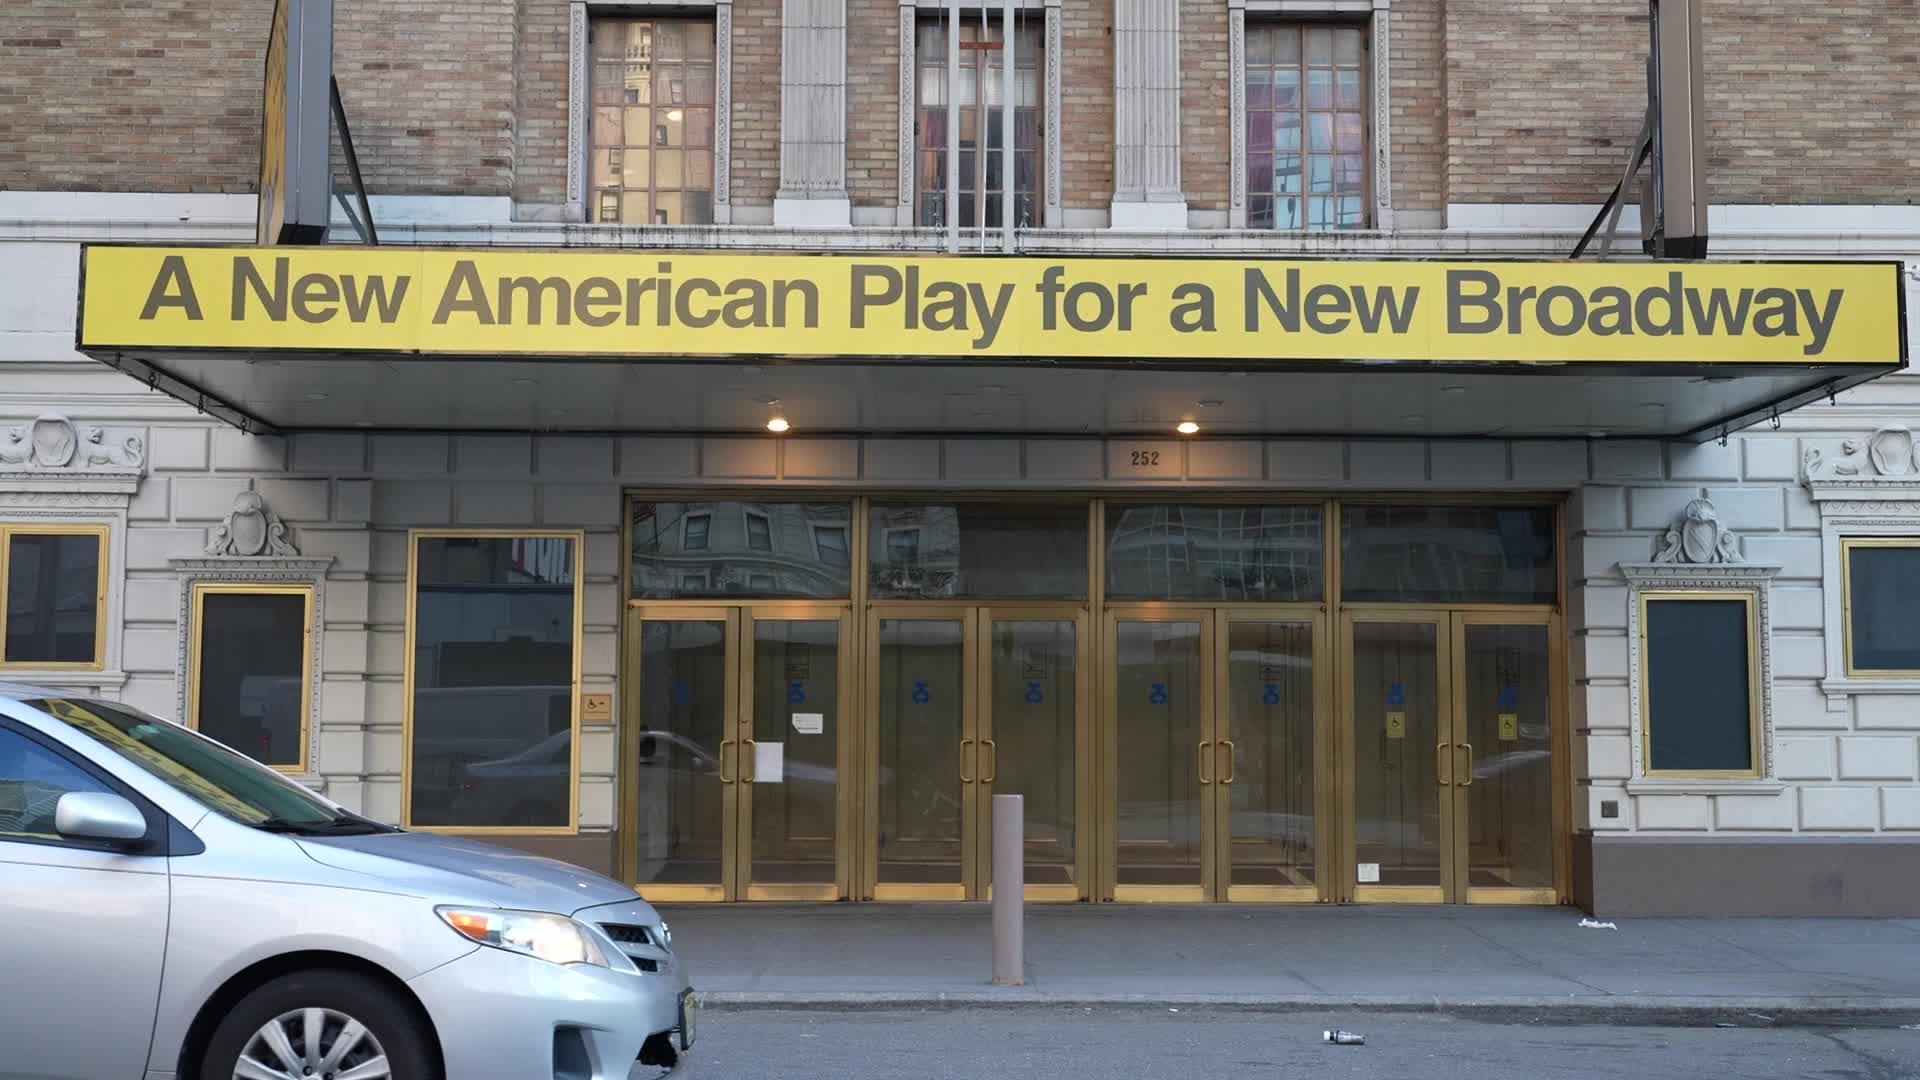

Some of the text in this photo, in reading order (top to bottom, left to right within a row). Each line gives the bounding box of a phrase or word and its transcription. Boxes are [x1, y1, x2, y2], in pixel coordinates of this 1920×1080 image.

[139, 255, 1845, 356] A New American Play for a New Broadway
[1131, 450, 1160, 466] 252
